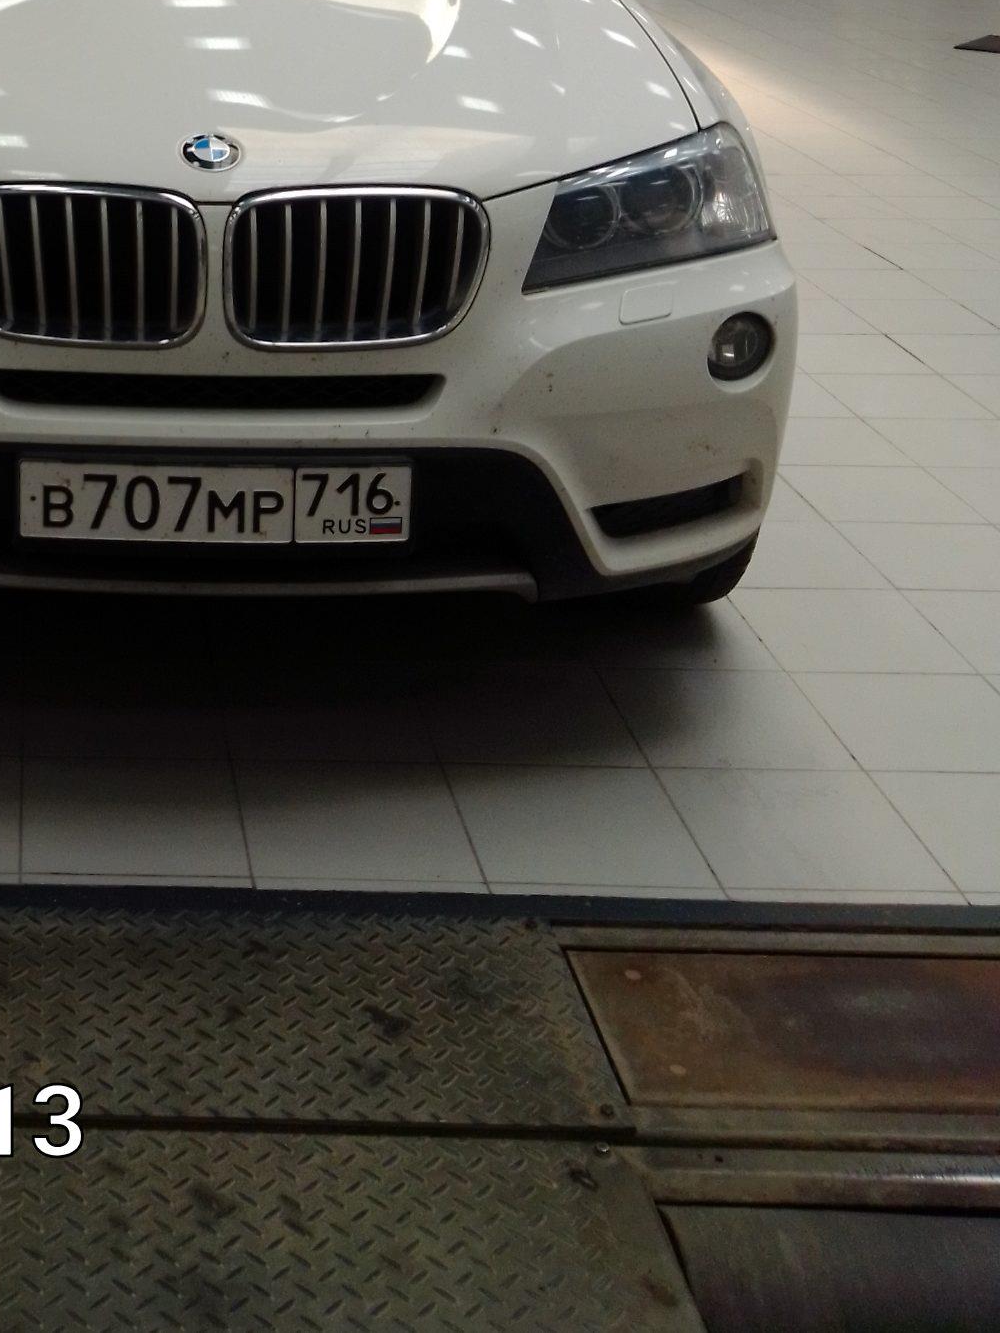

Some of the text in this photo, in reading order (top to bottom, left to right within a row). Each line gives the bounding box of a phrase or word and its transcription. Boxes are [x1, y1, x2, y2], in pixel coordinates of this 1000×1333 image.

[42, 473, 394, 533] В707МР 716
[322, 517, 367, 535] RUS
